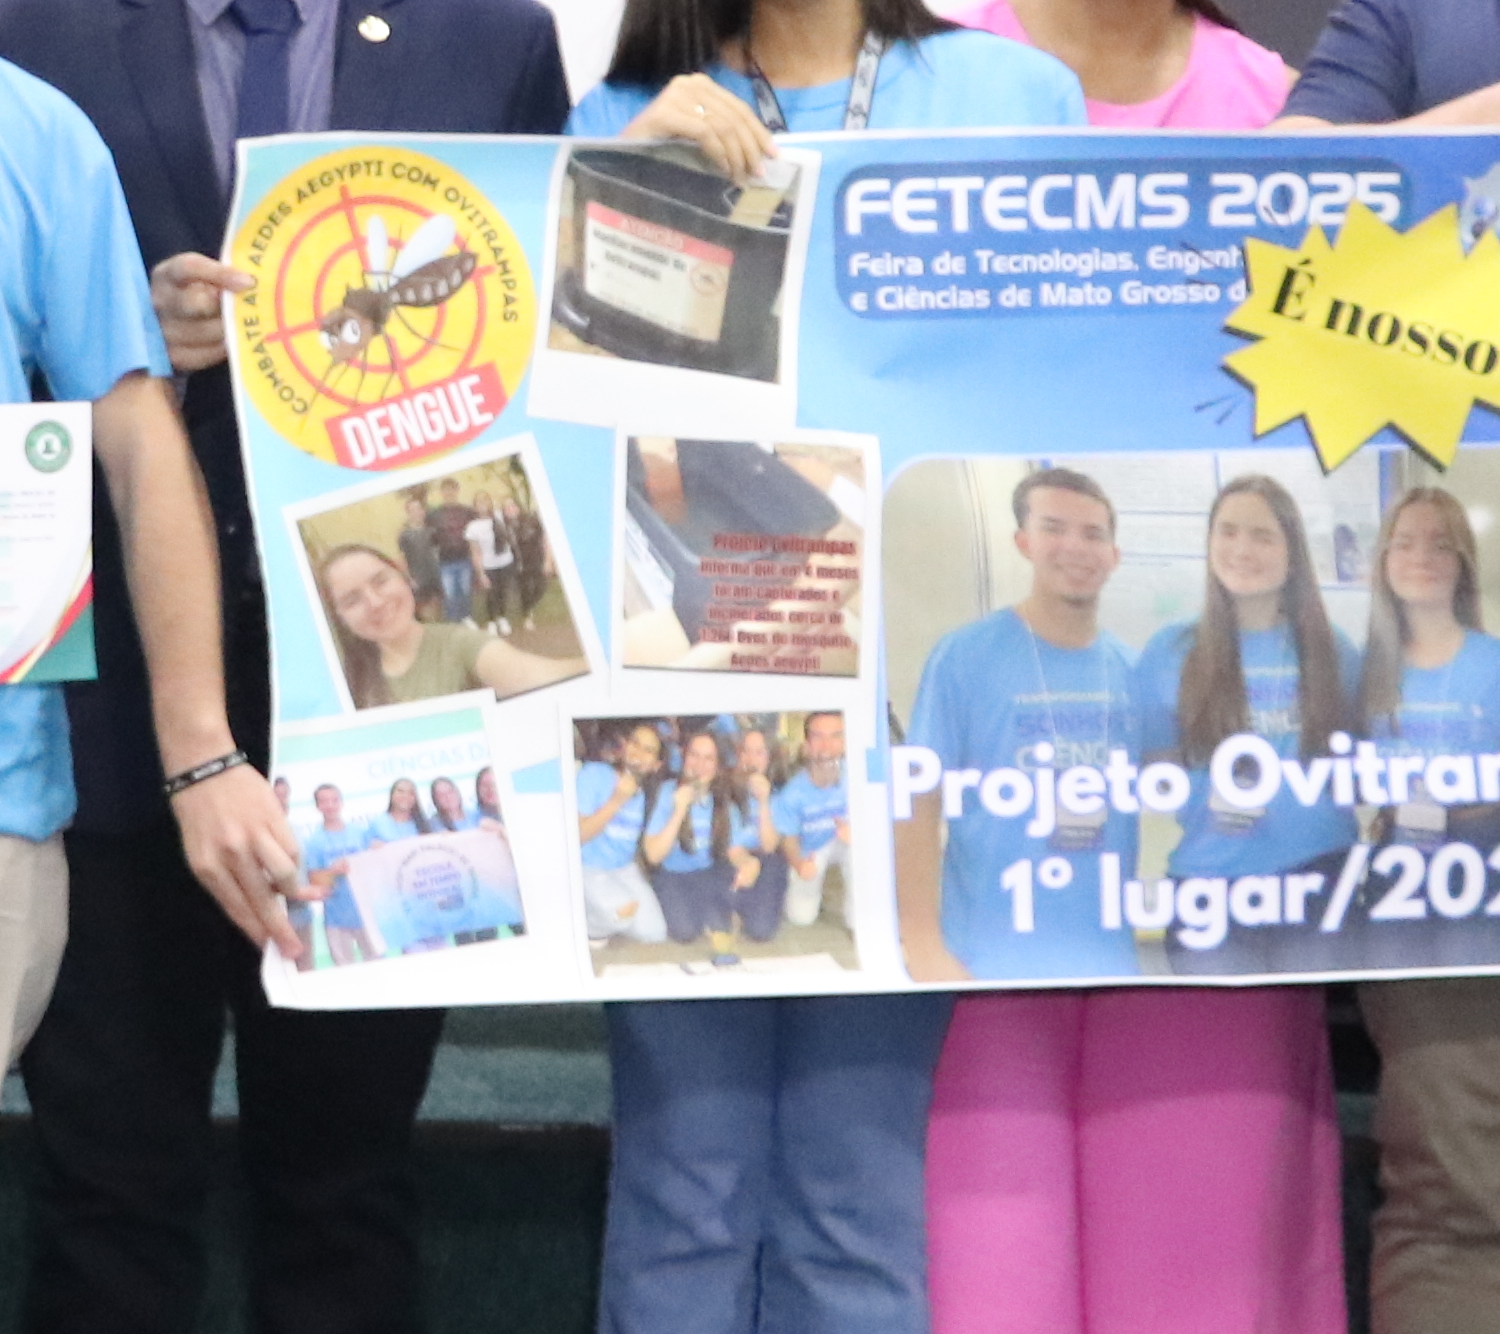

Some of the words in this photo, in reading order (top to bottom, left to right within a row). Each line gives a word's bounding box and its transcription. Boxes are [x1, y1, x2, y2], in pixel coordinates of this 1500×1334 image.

[295, 159, 384, 204] AEGYPTI
[391, 162, 440, 190] COM
[844, 172, 1192, 235] FETECMS
[1208, 171, 1401, 228] 2025
[248, 202, 293, 267] AEDES
[444, 185, 518, 323] OVITRAMPAS
[849, 252, 925, 278] Feira
[932, 250, 966, 276] de
[1146, 244, 1244, 276] Engenh
[850, 291, 869, 311] e
[875, 284, 992, 311] Ciências
[1000, 283, 1032, 308] de
[1039, 281, 1113, 308] Mato
[1119, 279, 1221, 305] Grosso
[1226, 278, 1247, 303] d
[1269, 258, 1316, 321] É
[243, 318, 309, 416] COMBATE
[341, 373, 496, 468] DENGUE
[890, 741, 1192, 839] Projeto
